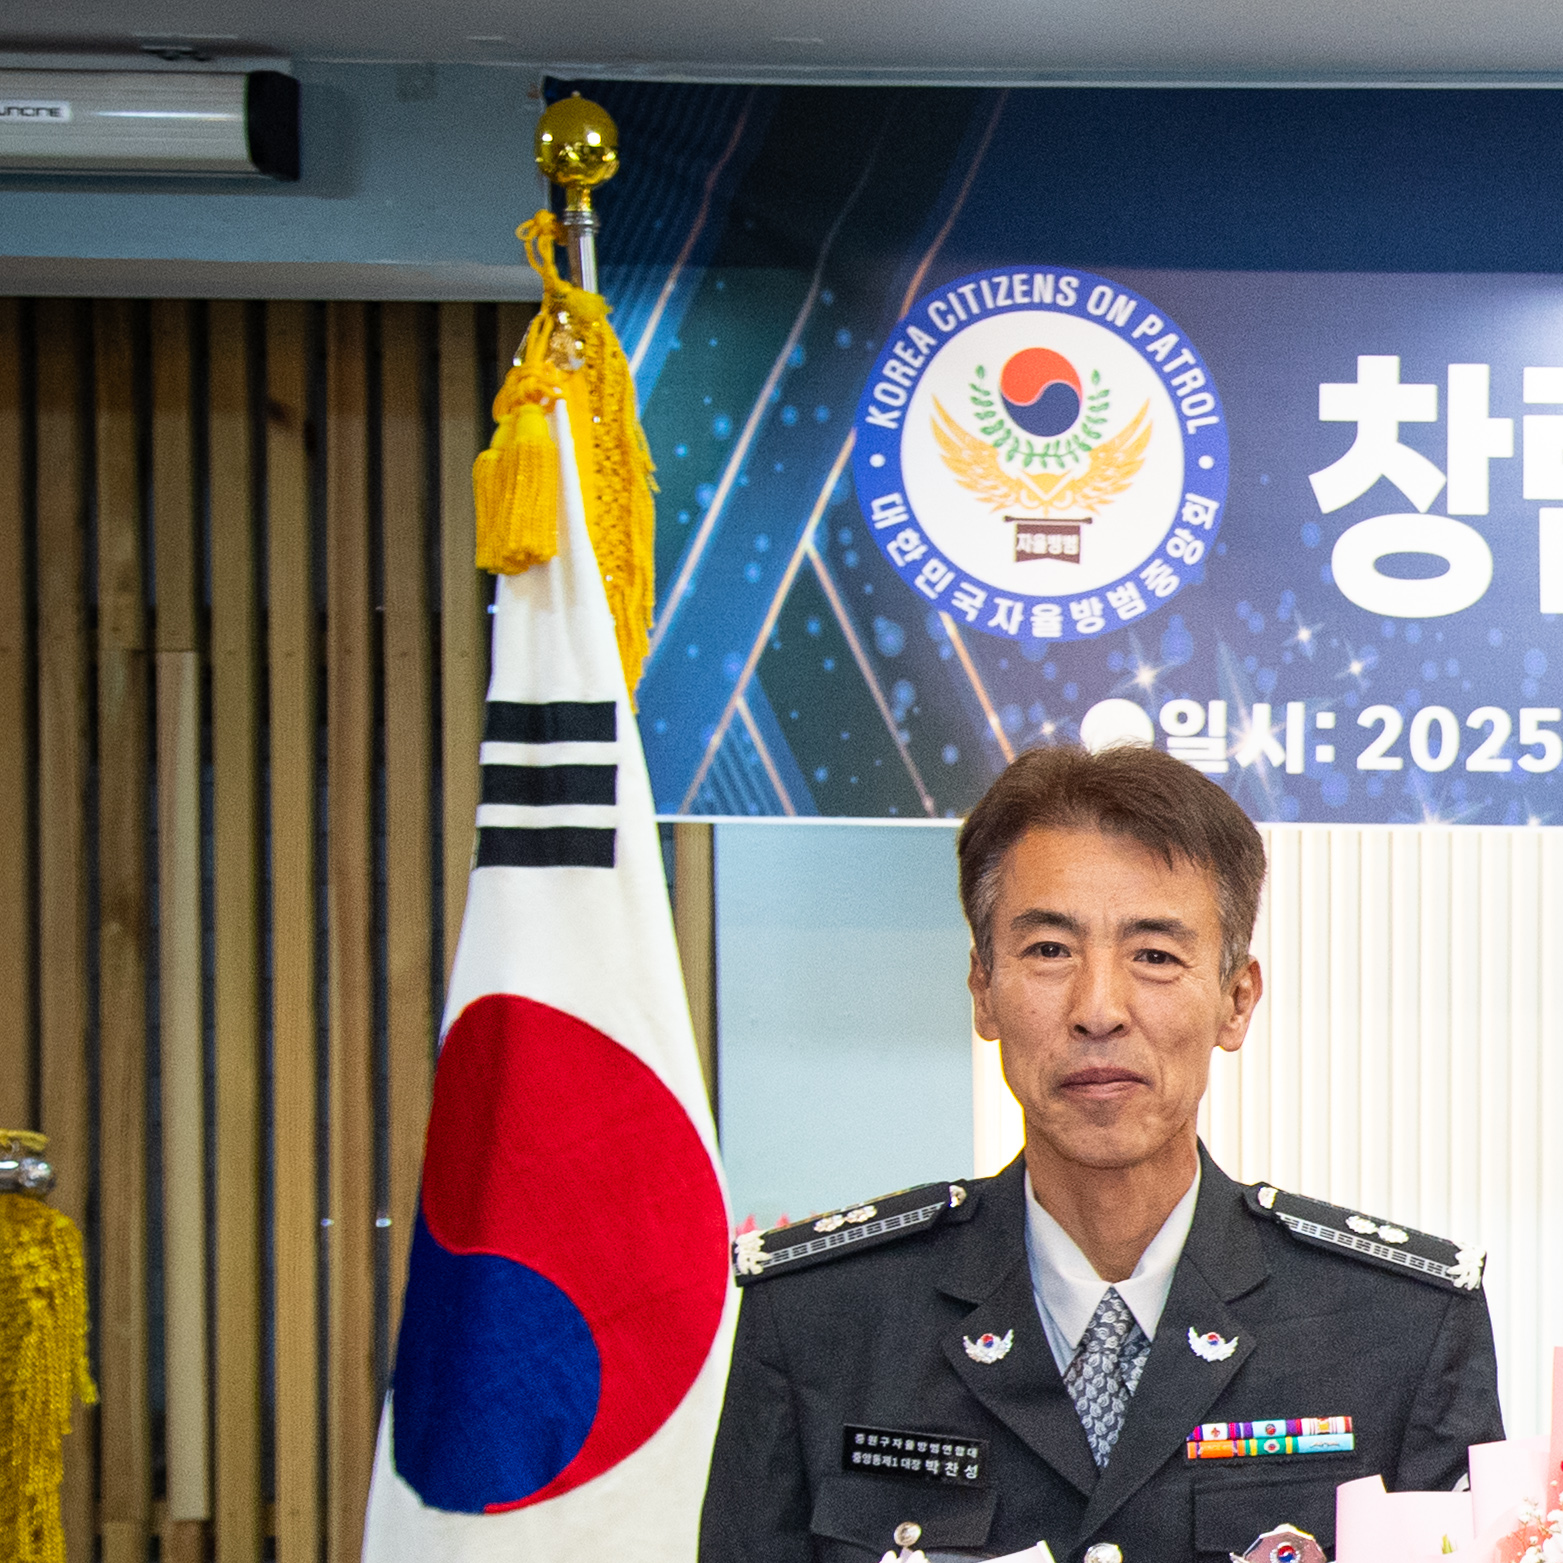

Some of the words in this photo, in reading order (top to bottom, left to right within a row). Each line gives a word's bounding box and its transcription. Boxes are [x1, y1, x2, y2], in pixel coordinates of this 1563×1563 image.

[867, 323, 936, 430] KOREA
[930, 274, 1078, 335] CITIZENS
[1086, 285, 1138, 326] ON
[1131, 312, 1221, 434] PATROL
[870, 491, 1222, 639] 대한민국자율방범중앙회
[1016, 533, 1080, 555] 자율방범
[1159, 699, 1336, 774] 일시:
